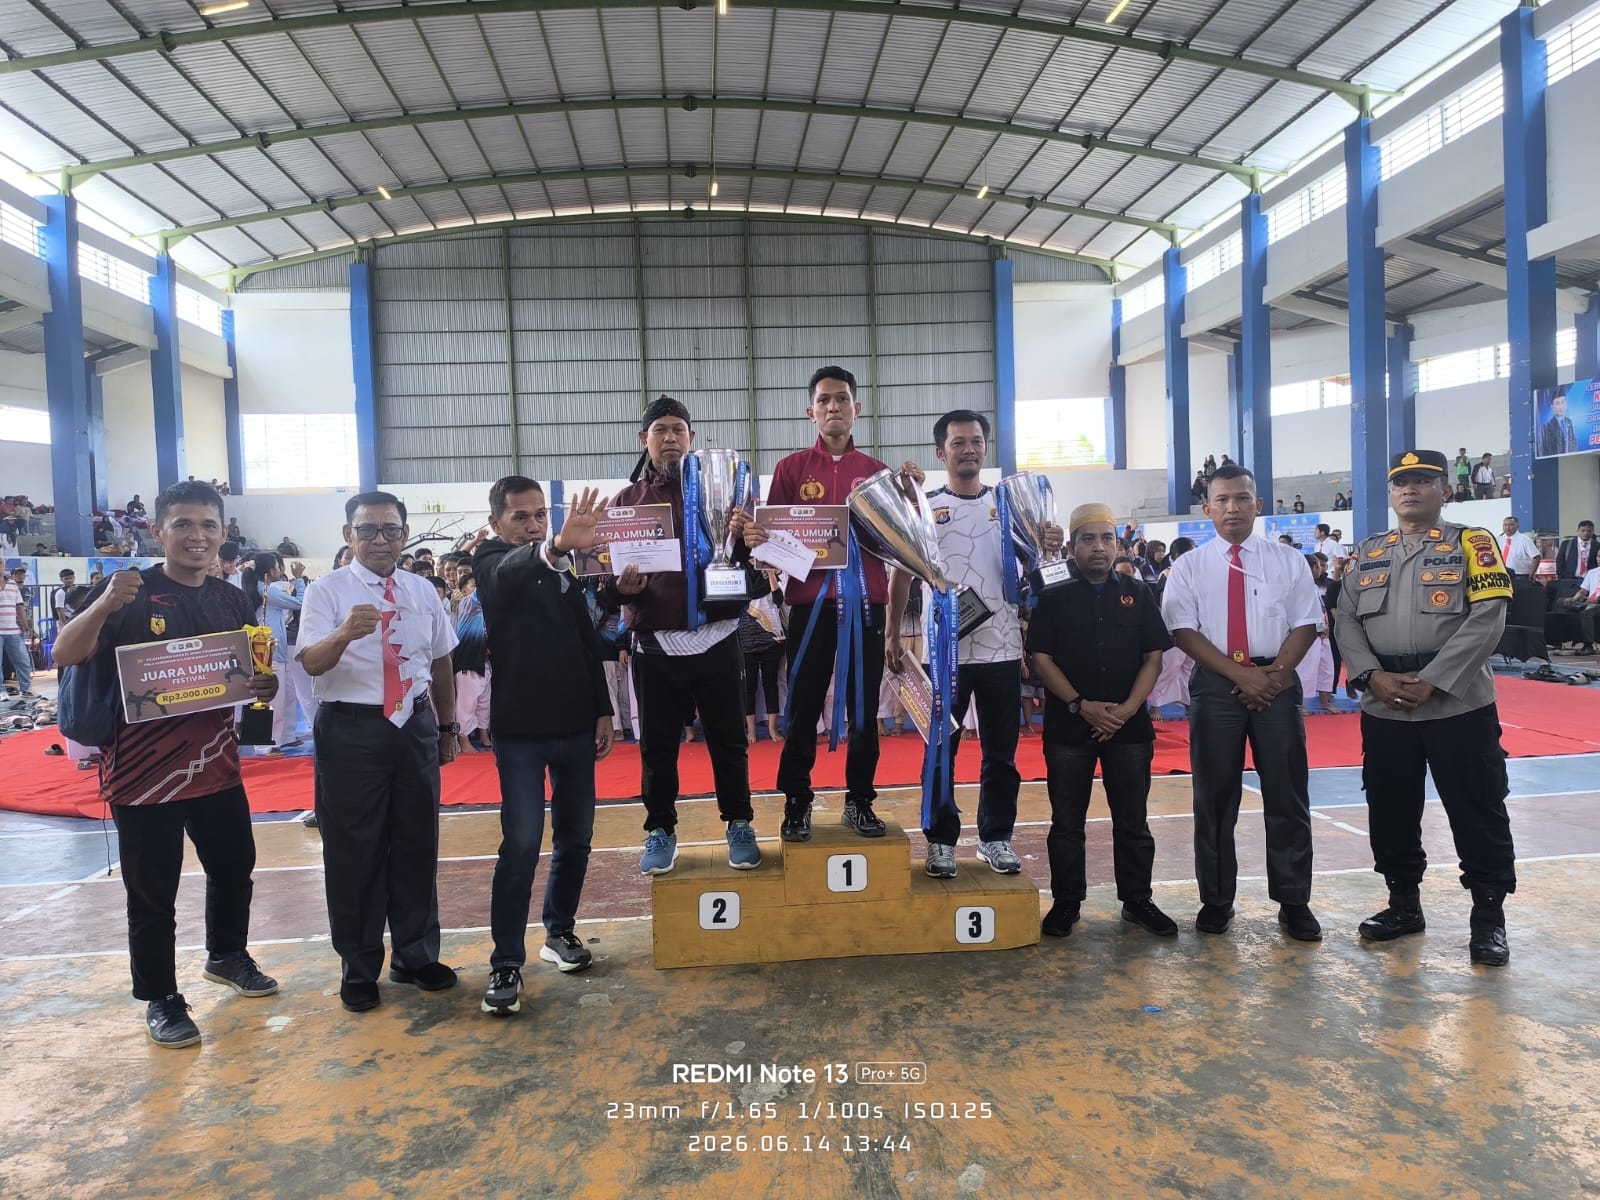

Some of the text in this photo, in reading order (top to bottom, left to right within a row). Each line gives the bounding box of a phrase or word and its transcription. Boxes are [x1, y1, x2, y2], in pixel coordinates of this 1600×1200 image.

[622, 528, 656, 539] UMUM
[657, 528, 664, 537] 2
[802, 528, 830, 537] UMUM
[834, 528, 838, 537] 1
[1424, 555, 1462, 567] POLRI
[140, 666, 186, 682] JUARA
[188, 660, 230, 675] UMUM
[231, 658, 238, 668] 1
[172, 674, 207, 685] FESTIVAL
[162, 686, 221, 703] Rp3.000.000
[902, 672, 921, 698] JUARA
[842, 859, 853, 886] 1
[712, 898, 727, 923] 2
[968, 911, 982, 938] 3
